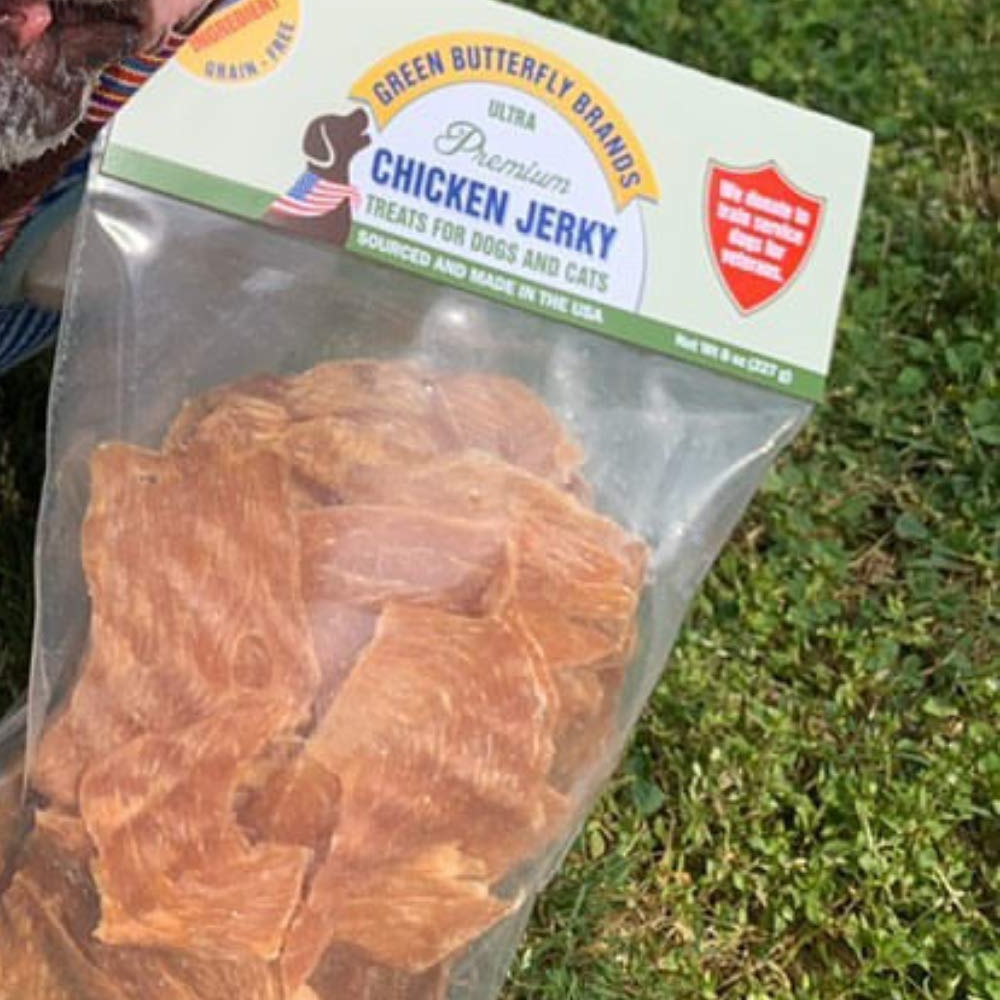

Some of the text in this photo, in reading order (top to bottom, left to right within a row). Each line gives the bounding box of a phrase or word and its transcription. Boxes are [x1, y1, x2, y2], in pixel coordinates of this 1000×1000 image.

[204, 59, 259, 80] GRAIN
[265, 19, 296, 63] FREE
[371, 45, 641, 190] GREEN BUTTERFLY BRANDS
[433, 120, 572, 195] Premium
[487, 98, 538, 132] ULTRA
[365, 193, 611, 293] TREATS FOR DOGS AND CATS
[370, 148, 618, 261] CHICKEN JERKY
[357, 229, 604, 323] SOURCED AND MADE IN THE USA
